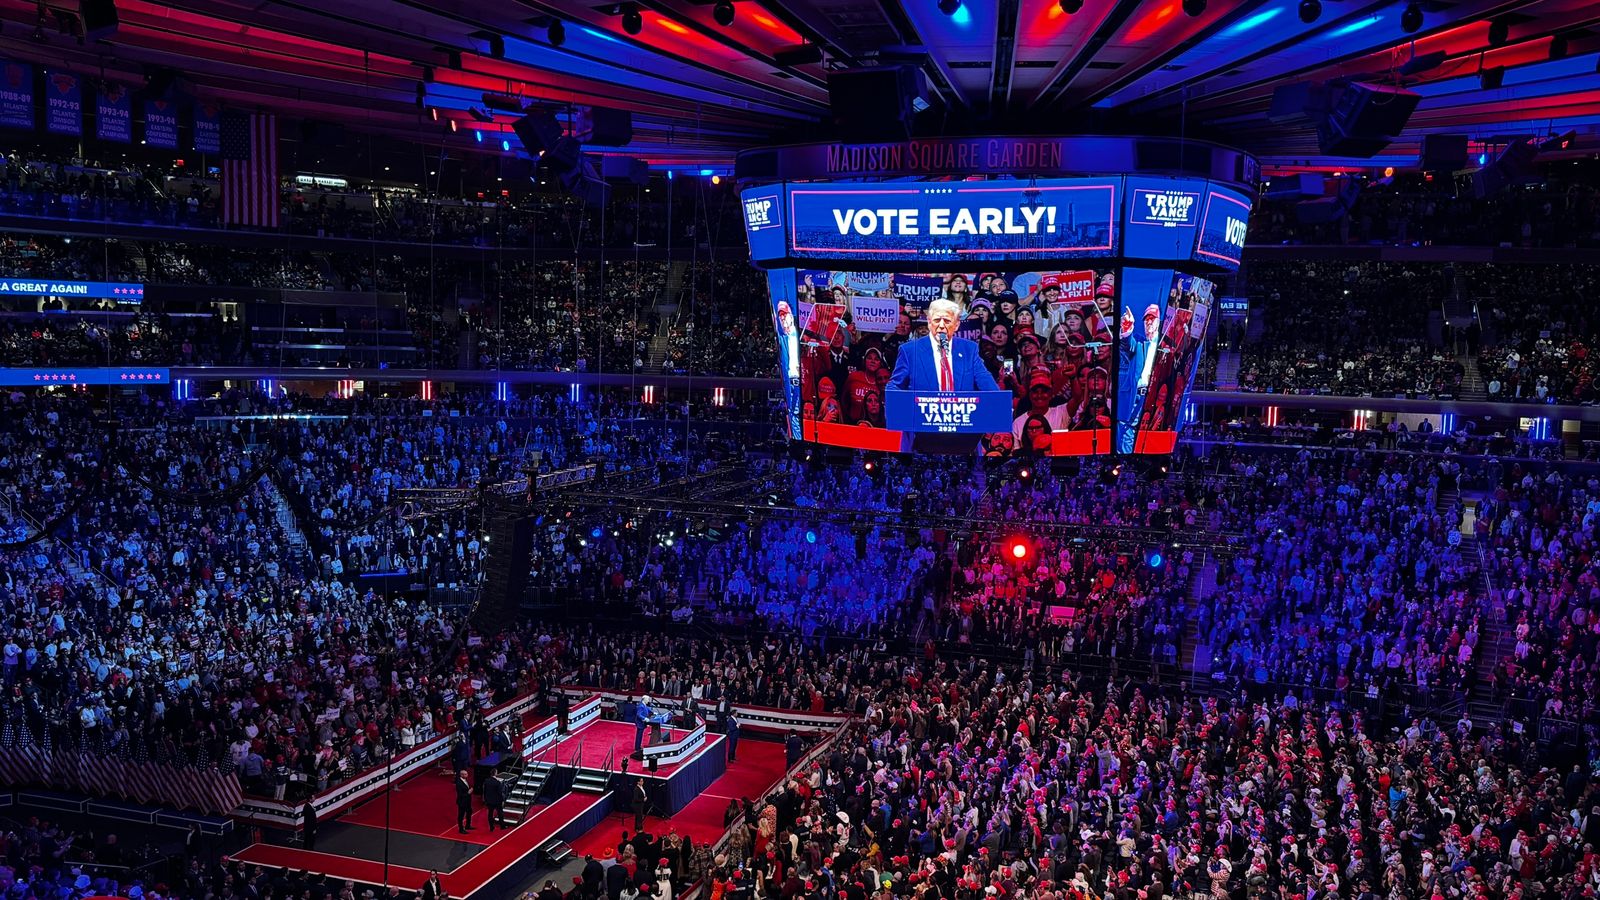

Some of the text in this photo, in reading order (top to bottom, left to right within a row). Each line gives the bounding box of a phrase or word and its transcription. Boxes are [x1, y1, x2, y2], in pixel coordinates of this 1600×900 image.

[49, 98, 80, 110] 1992-93
[99, 105, 129, 118] 1993-94
[147, 113, 176, 125] 1993-94
[826, 139, 1062, 172] MADISON SQUARE GARDEN
[1145, 194, 1193, 208] TRUMP
[1150, 206, 1188, 217] VANCE
[833, 207, 1056, 235] VOTE EARLY!
[848, 271, 887, 280] TRUMP
[12, 283, 48, 292] GREAT
[50, 284, 88, 294] AGAIN!
[895, 283, 941, 296] TRUMP
[1059, 280, 1092, 293] UMP
[1068, 290, 1082, 298] FIX
[856, 306, 895, 318] TRUMP
[856, 315, 874, 323] WILL
[918, 403, 976, 414] TRUMP
[924, 413, 970, 423] VANCE
